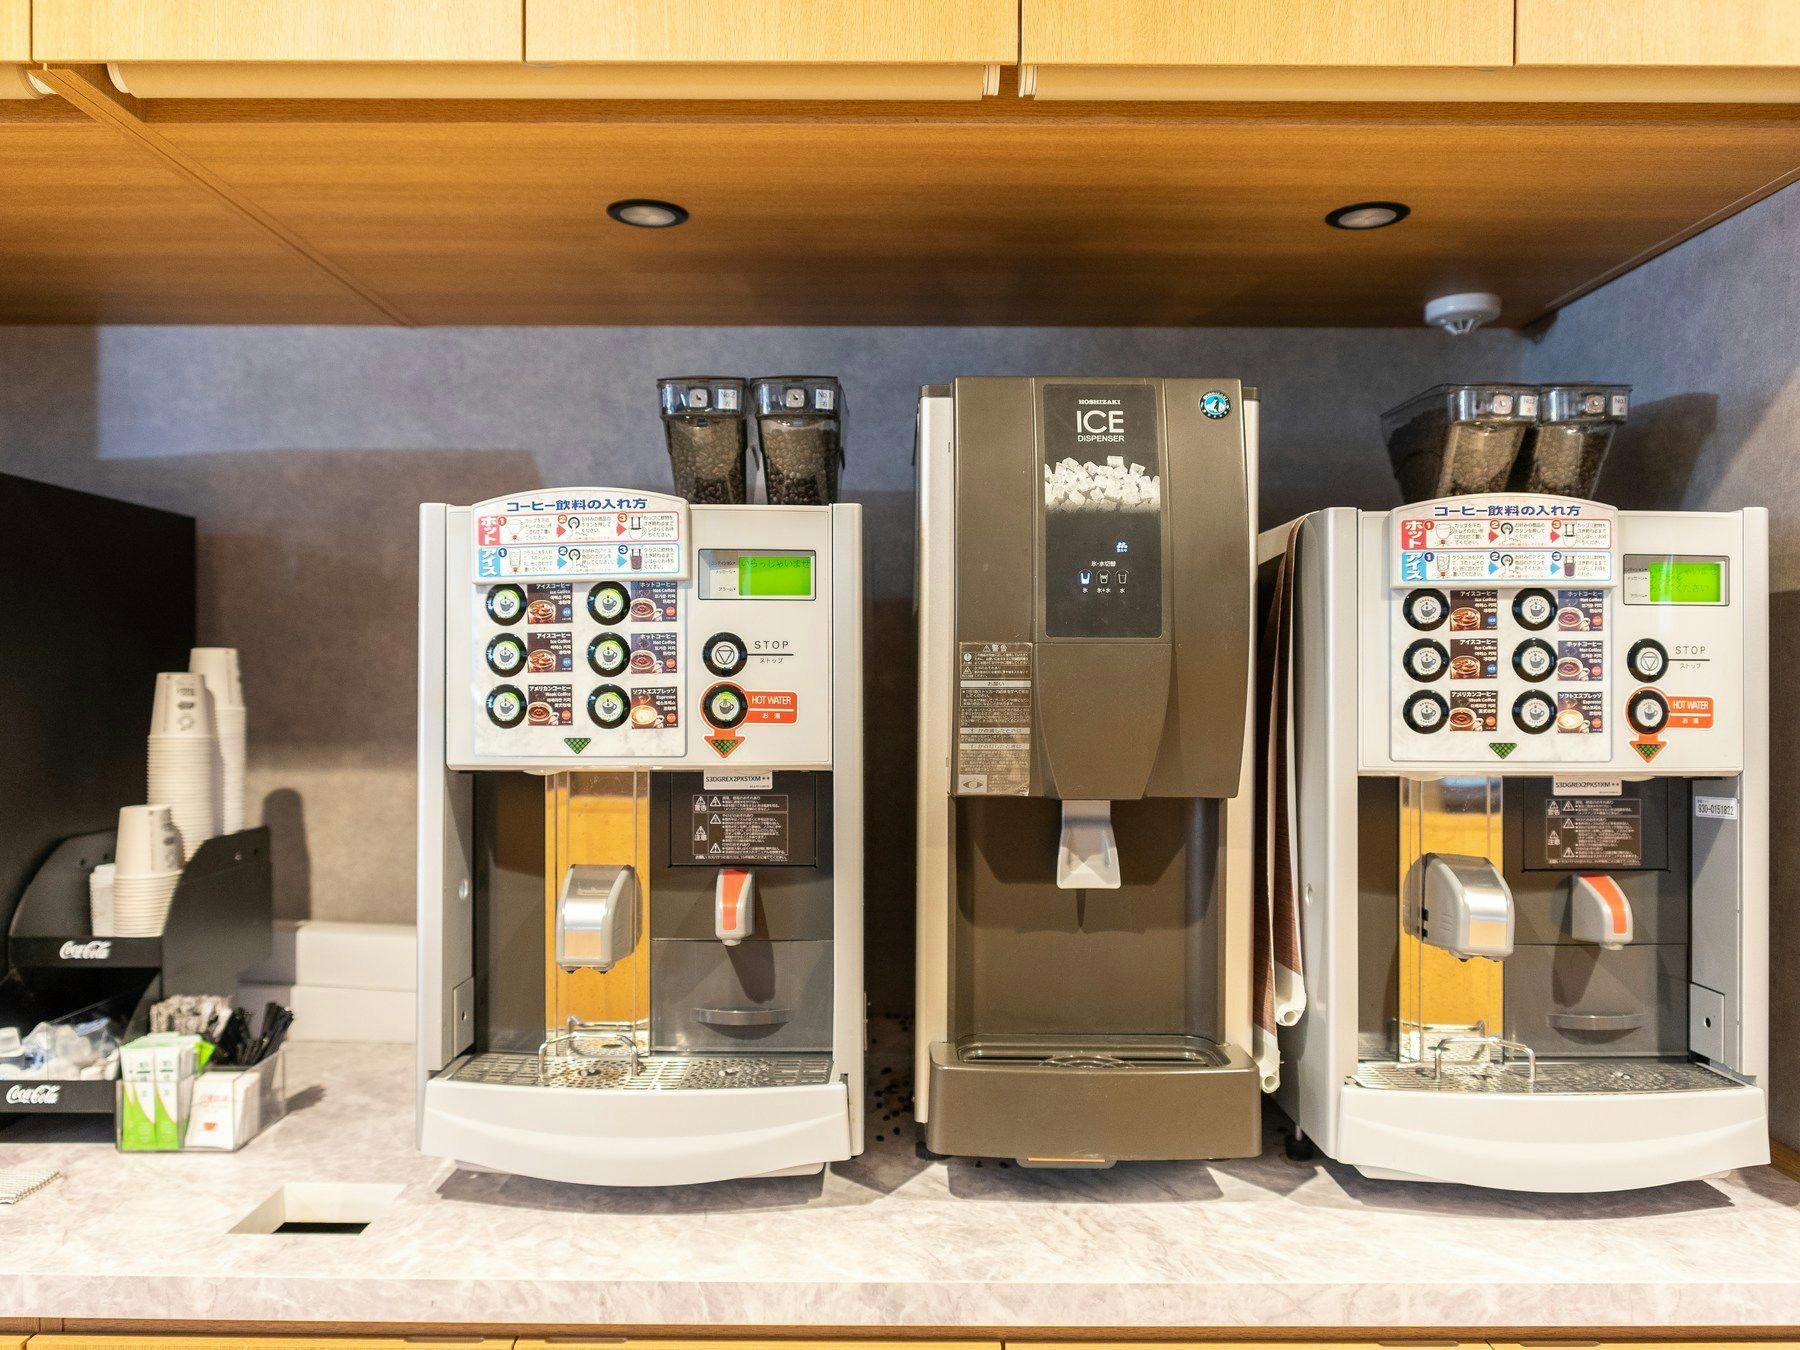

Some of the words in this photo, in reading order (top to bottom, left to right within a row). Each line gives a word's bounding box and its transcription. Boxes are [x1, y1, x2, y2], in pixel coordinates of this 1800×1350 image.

[1076, 410, 1125, 433] ICE
[507, 498, 648, 512] コーヒー飲料の入れ方
[1434, 505, 1582, 517] コーヒー飲料の入れ方
[1405, 520, 1424, 549] ホット
[1405, 553, 1424, 580] アイス
[754, 640, 789, 650] STOP
[1675, 646, 1707, 654] STOP
[751, 696, 766, 705] HOT
[767, 696, 791, 705] WATER
[1672, 701, 1686, 709] HOT
[1687, 701, 1709, 710] WATER
